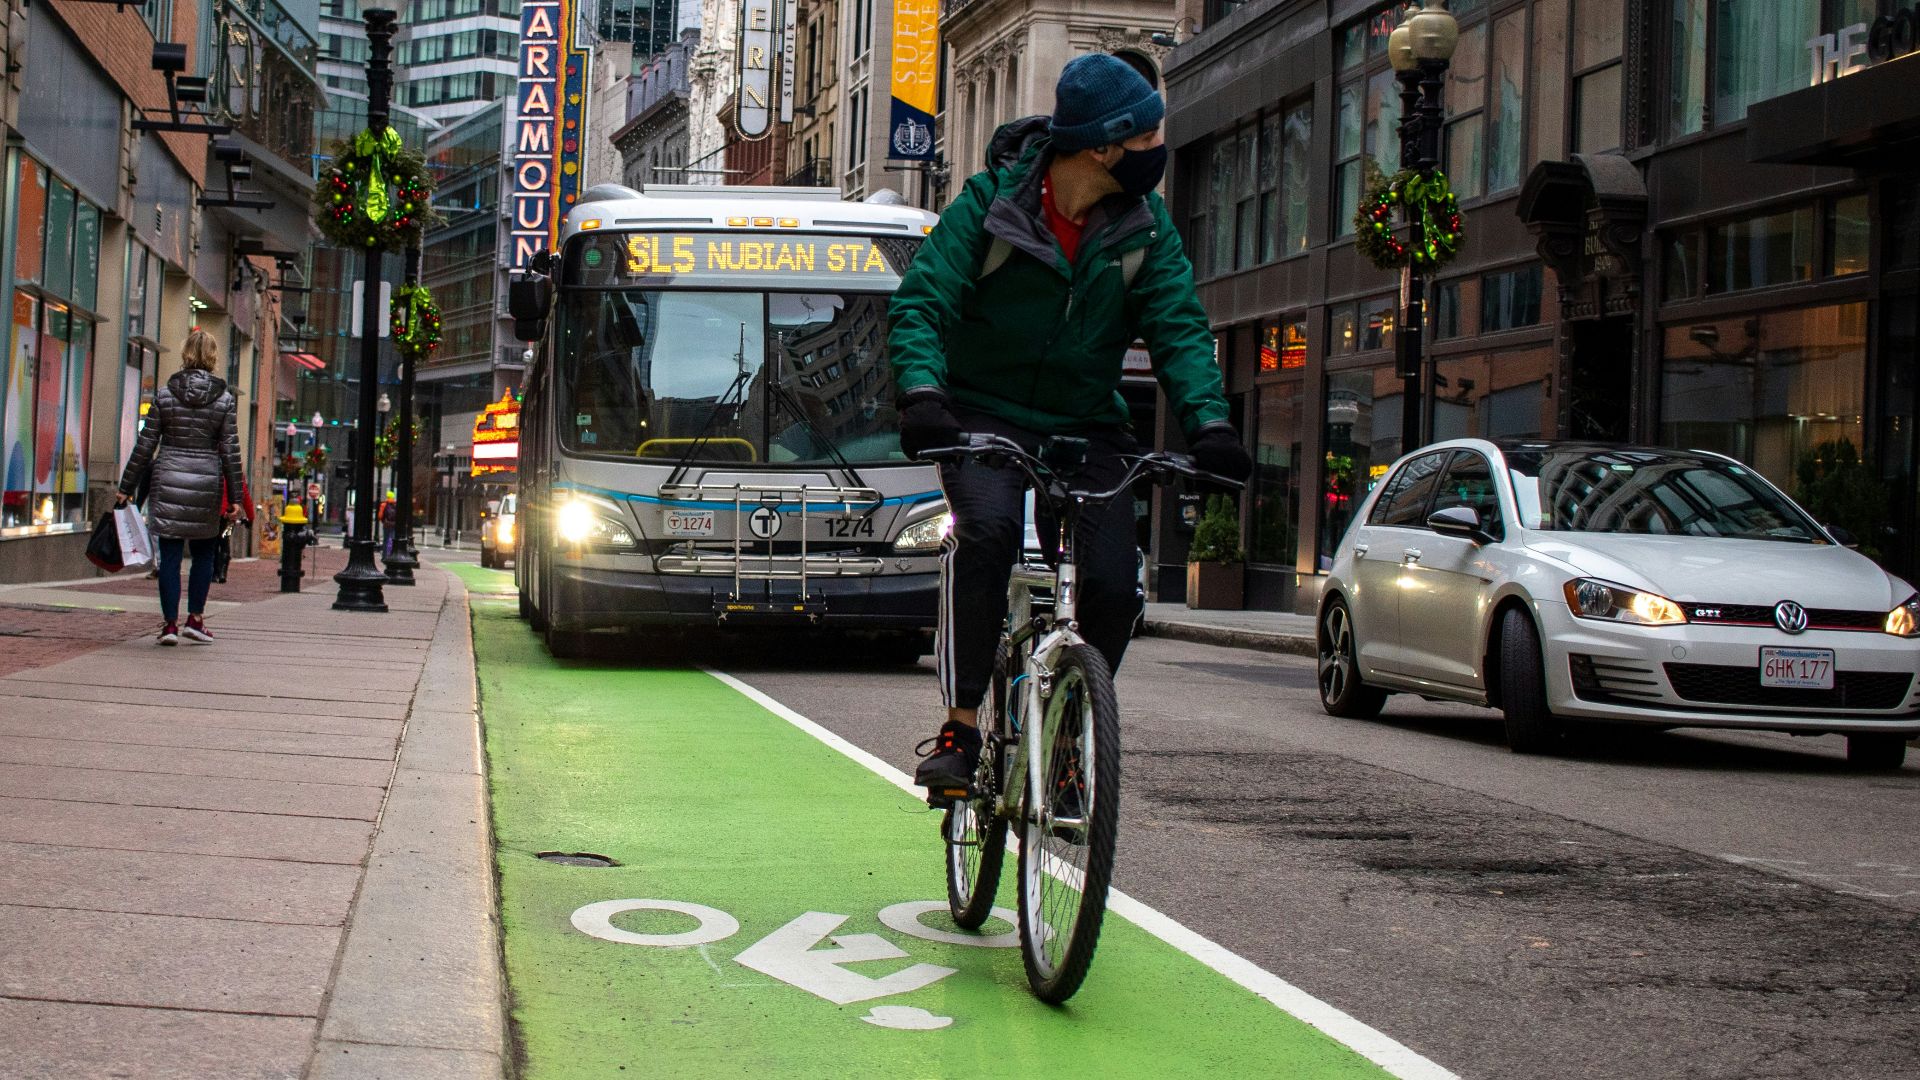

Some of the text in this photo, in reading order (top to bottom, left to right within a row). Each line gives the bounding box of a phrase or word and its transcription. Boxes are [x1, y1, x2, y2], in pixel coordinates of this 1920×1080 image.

[744, 8, 767, 108] ERN
[783, 23, 796, 97] SUFFOLK
[1806, 22, 1867, 86] THE
[628, 236, 885, 273] SL5 NUBIAN STA
[683, 517, 711, 530] 1274
[825, 517, 875, 538] 1274
[1695, 609, 1721, 617] GTI
[1765, 658, 1829, 680] 6HK 177
